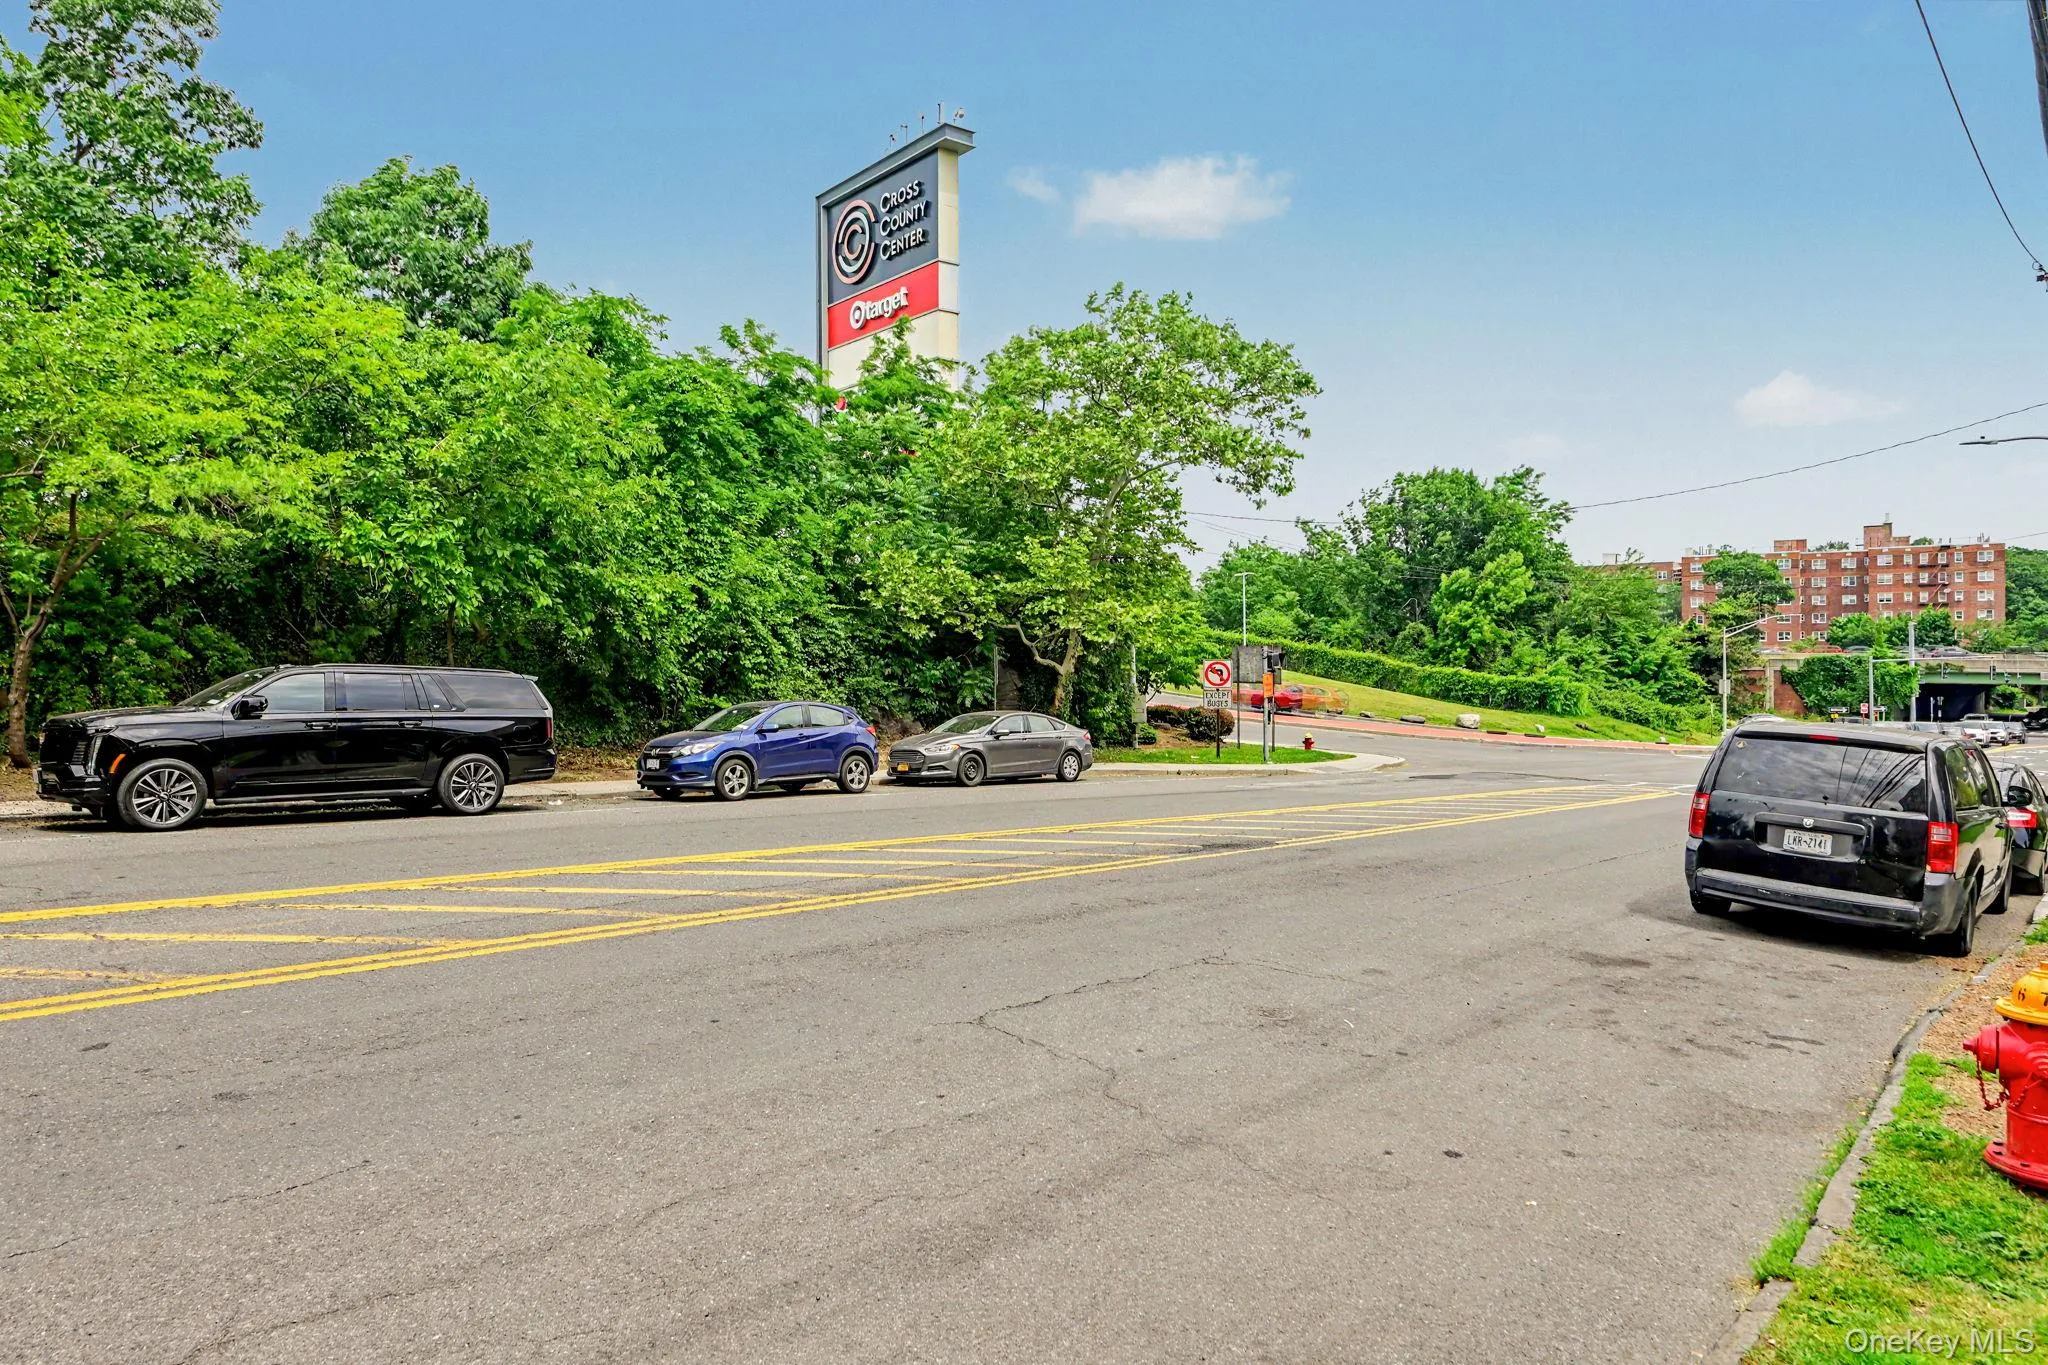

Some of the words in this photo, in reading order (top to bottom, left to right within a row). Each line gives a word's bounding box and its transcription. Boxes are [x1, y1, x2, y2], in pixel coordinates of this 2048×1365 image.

[880, 180, 919, 213] CROSS
[880, 201, 926, 236] COUNTY
[880, 228, 924, 260] CENTER
[866, 286, 909, 320] target
[1206, 691, 1229, 699] EXCEPT
